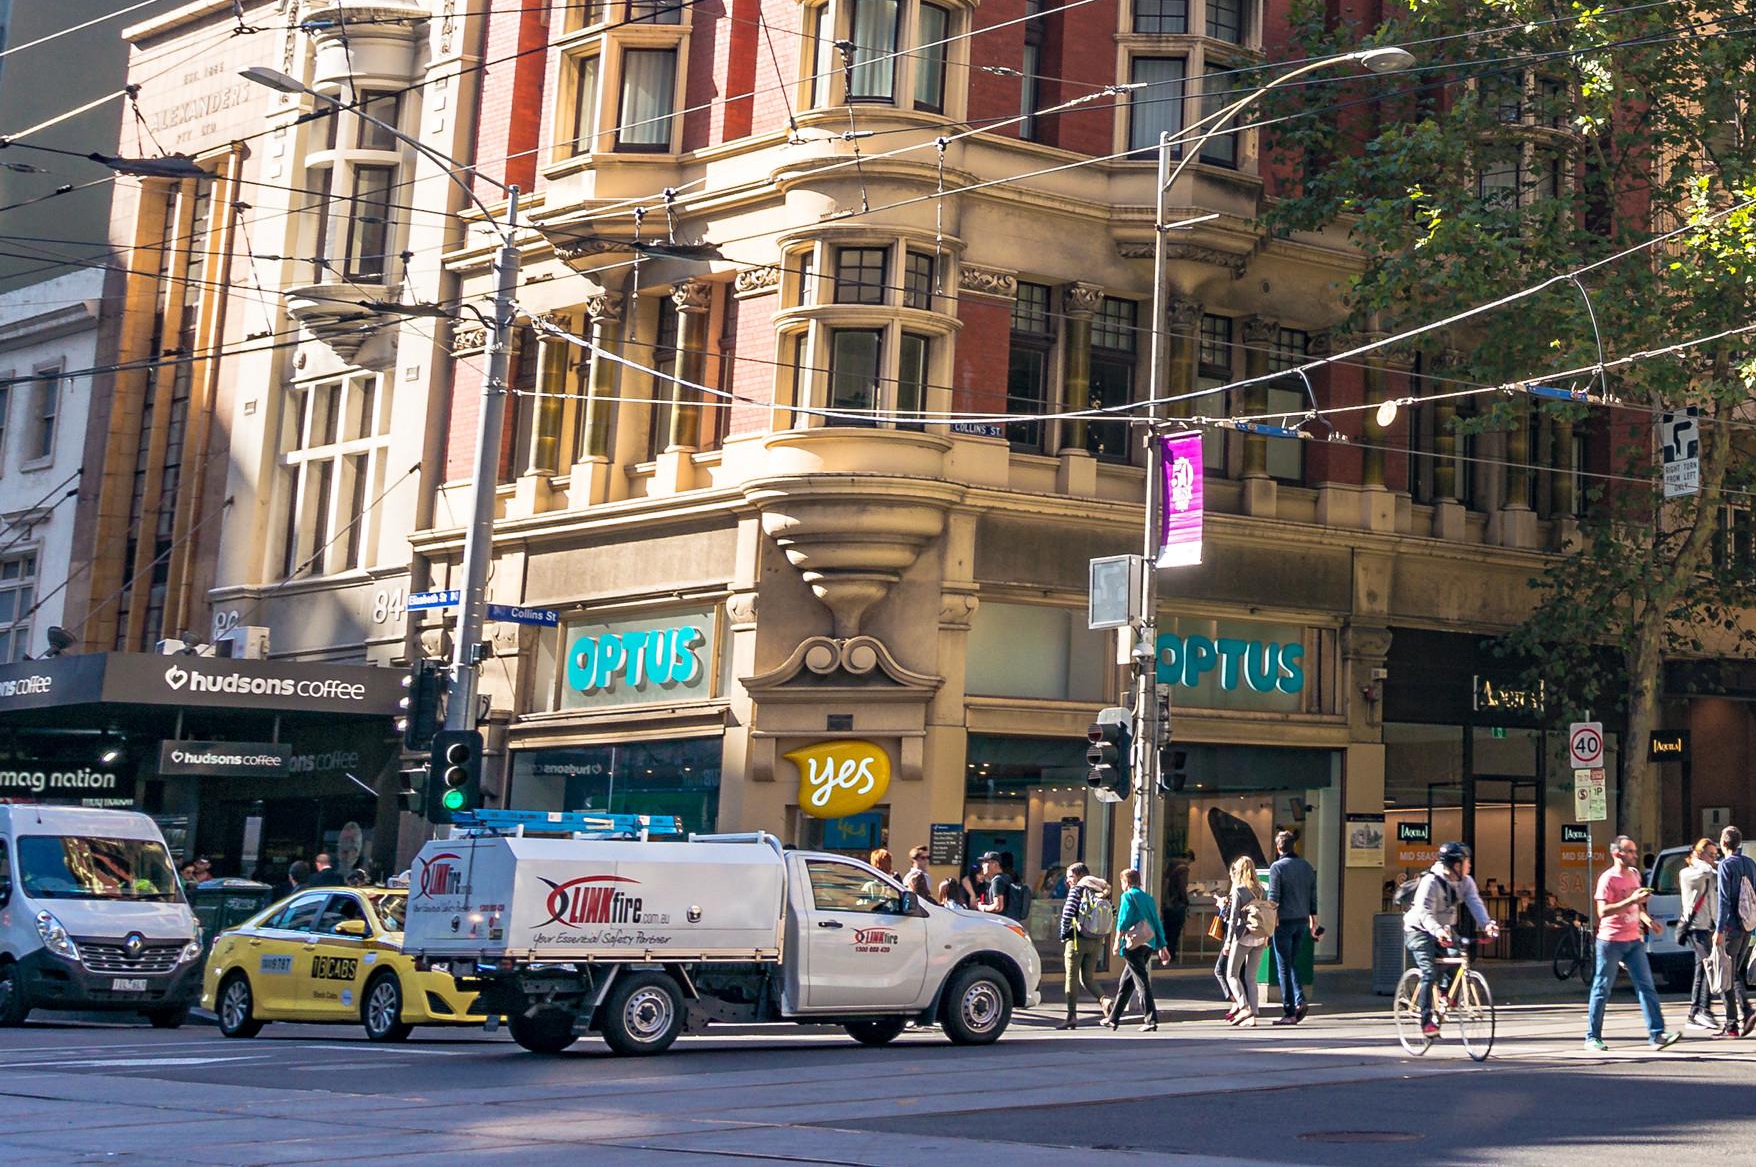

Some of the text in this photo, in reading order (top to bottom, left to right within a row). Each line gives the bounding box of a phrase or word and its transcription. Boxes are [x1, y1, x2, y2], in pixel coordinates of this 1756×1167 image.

[151, 81, 250, 132] ALEXANDERS
[1171, 462, 1194, 487] 50
[1666, 462, 1697, 473] RIGHT TURN
[1684, 471, 1696, 480] LEFT
[373, 588, 404, 624] 84
[511, 607, 556, 622] Collins St
[568, 626, 701, 691] OPTUS
[1155, 634, 1305, 694] OPTUS
[15, 675, 52, 695] coffee
[189, 671, 366, 700] hudsons coffee
[1575, 737, 1598, 753] 40
[184, 751, 281, 766] hudsons coffee
[316, 750, 359, 770] coffee
[0, 767, 116, 792] mag nation
[808, 757, 875, 806] yes
[1593, 787, 1603, 796] 1P
[1400, 851, 1415, 861] MID
[1562, 852, 1575, 861] MID
[533, 929, 672, 947] Your Essential Safety Partner
